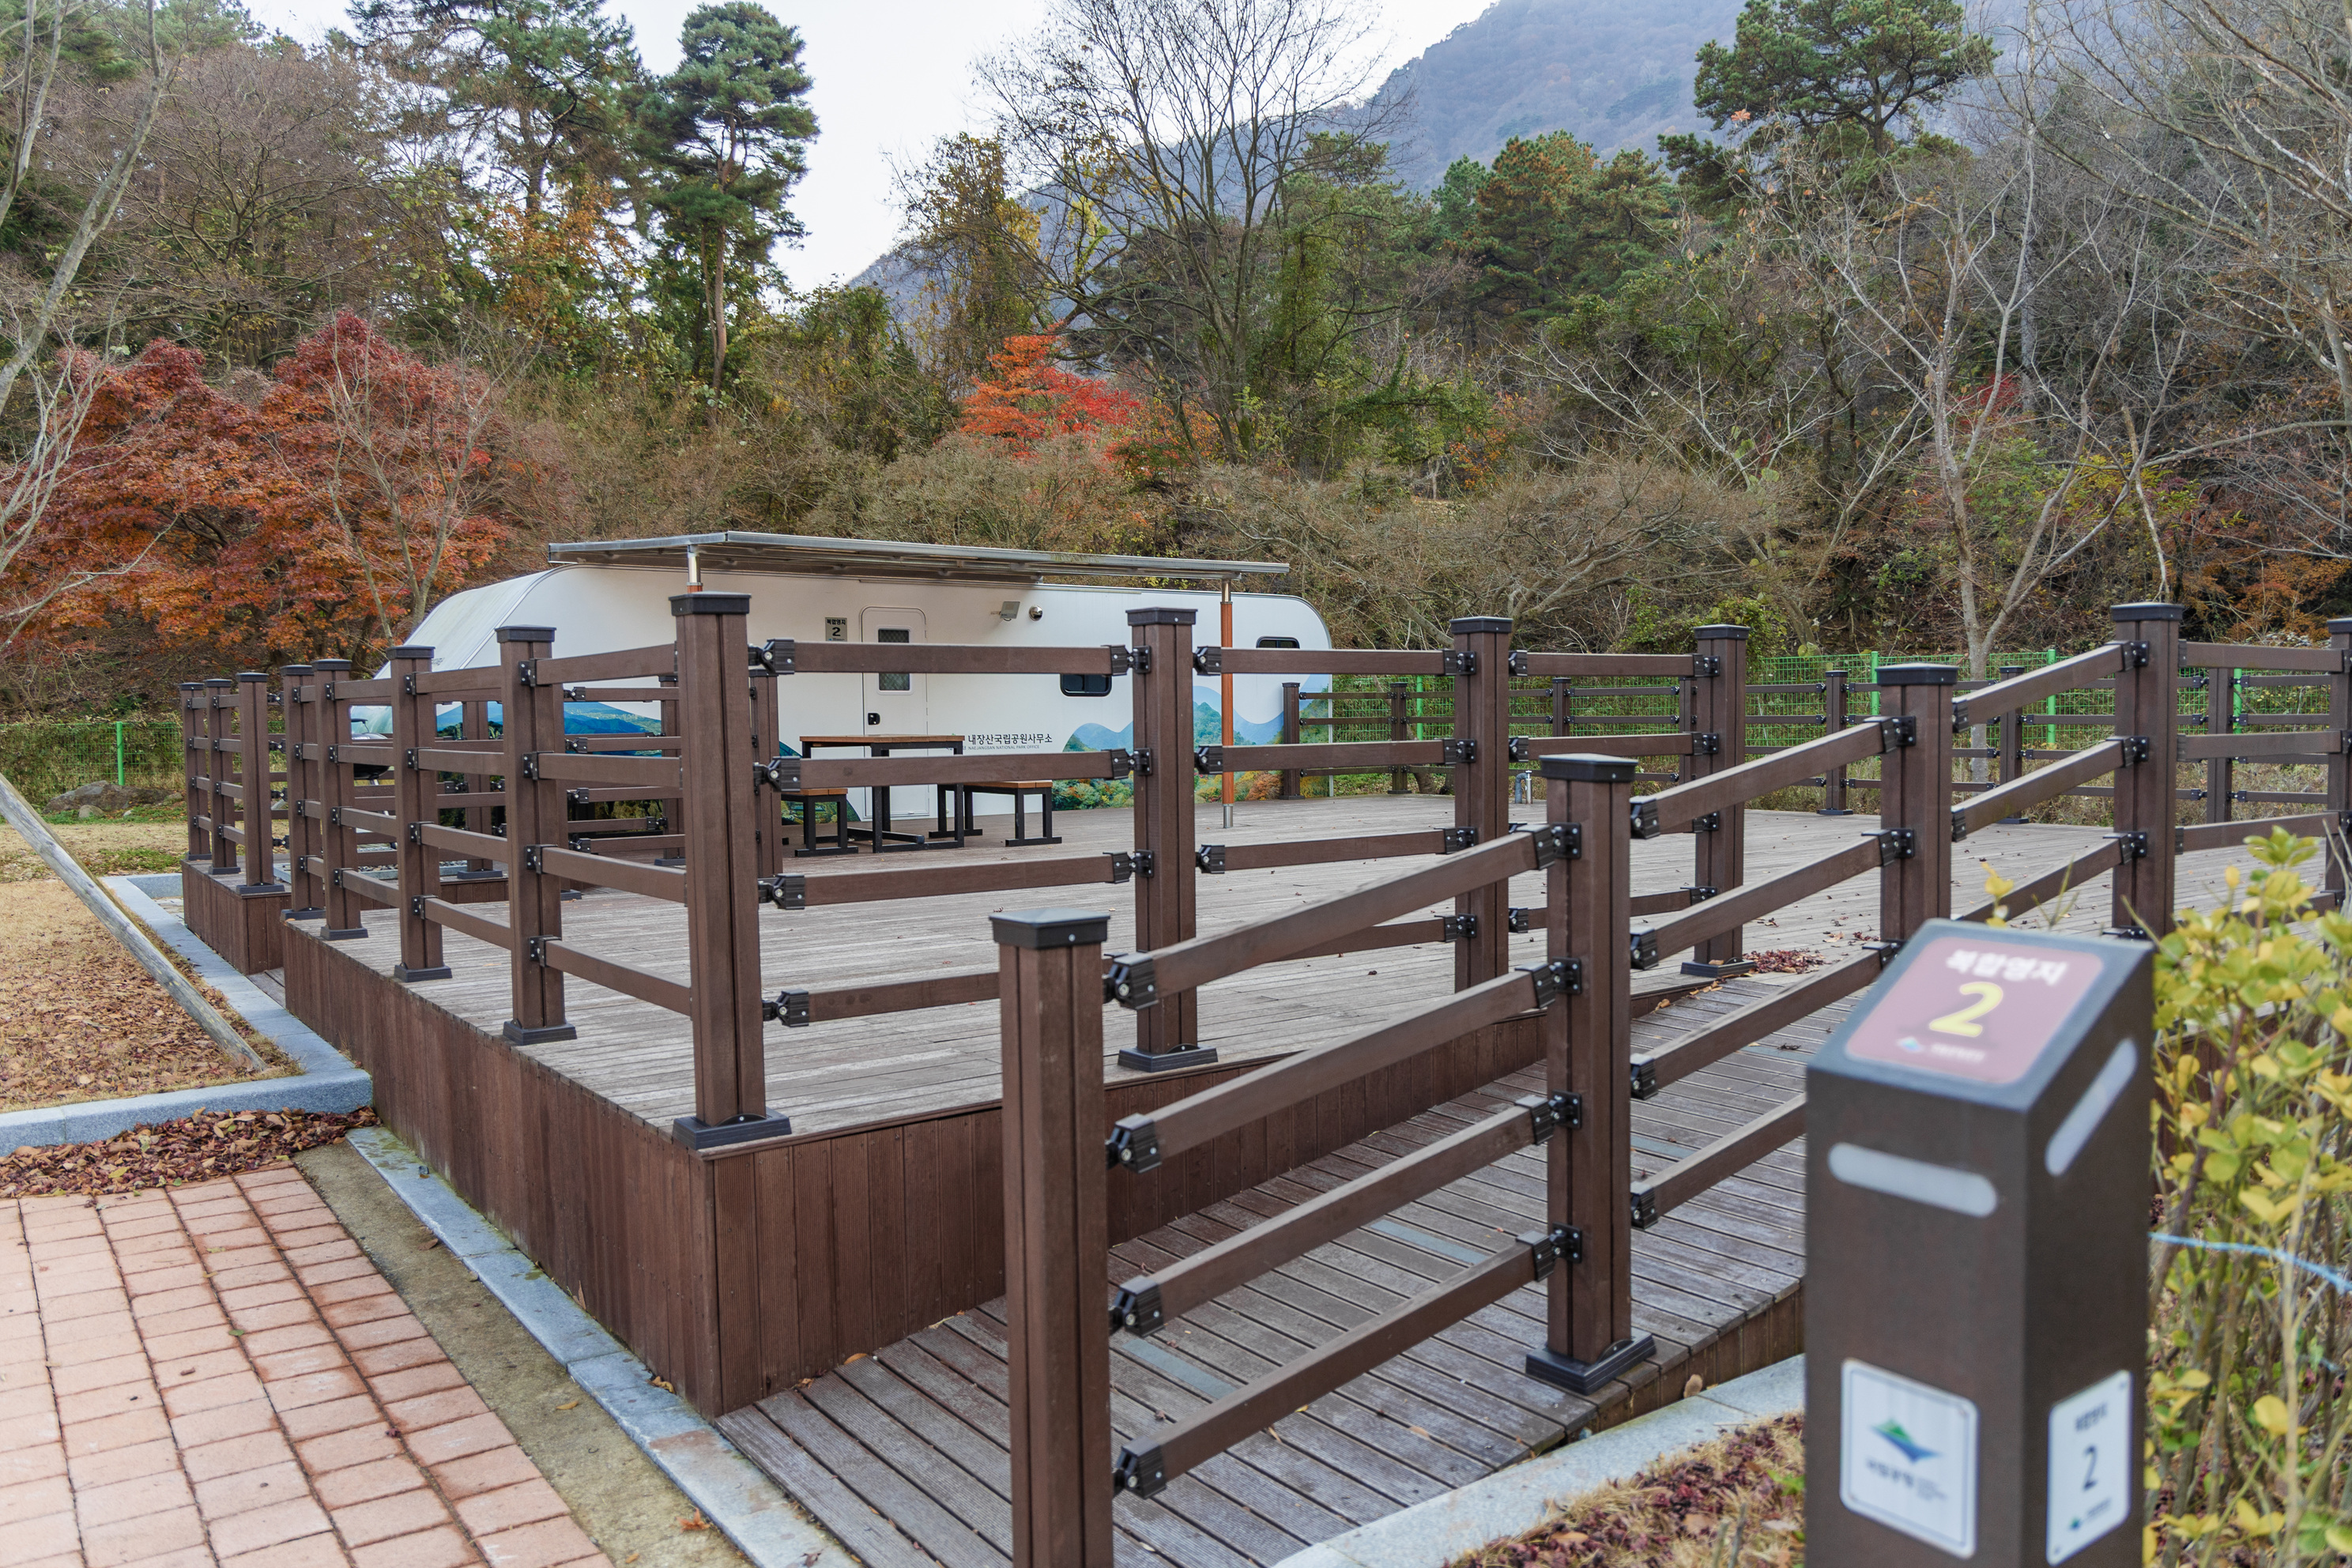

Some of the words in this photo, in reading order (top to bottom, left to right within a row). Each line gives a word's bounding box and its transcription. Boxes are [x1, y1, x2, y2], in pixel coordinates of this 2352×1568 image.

[832, 627, 841, 636] 2
[968, 733, 1053, 745] 내장산국립공원사무소
[1928, 981, 2003, 1038] 2
[2082, 1445, 2098, 1492] 2
